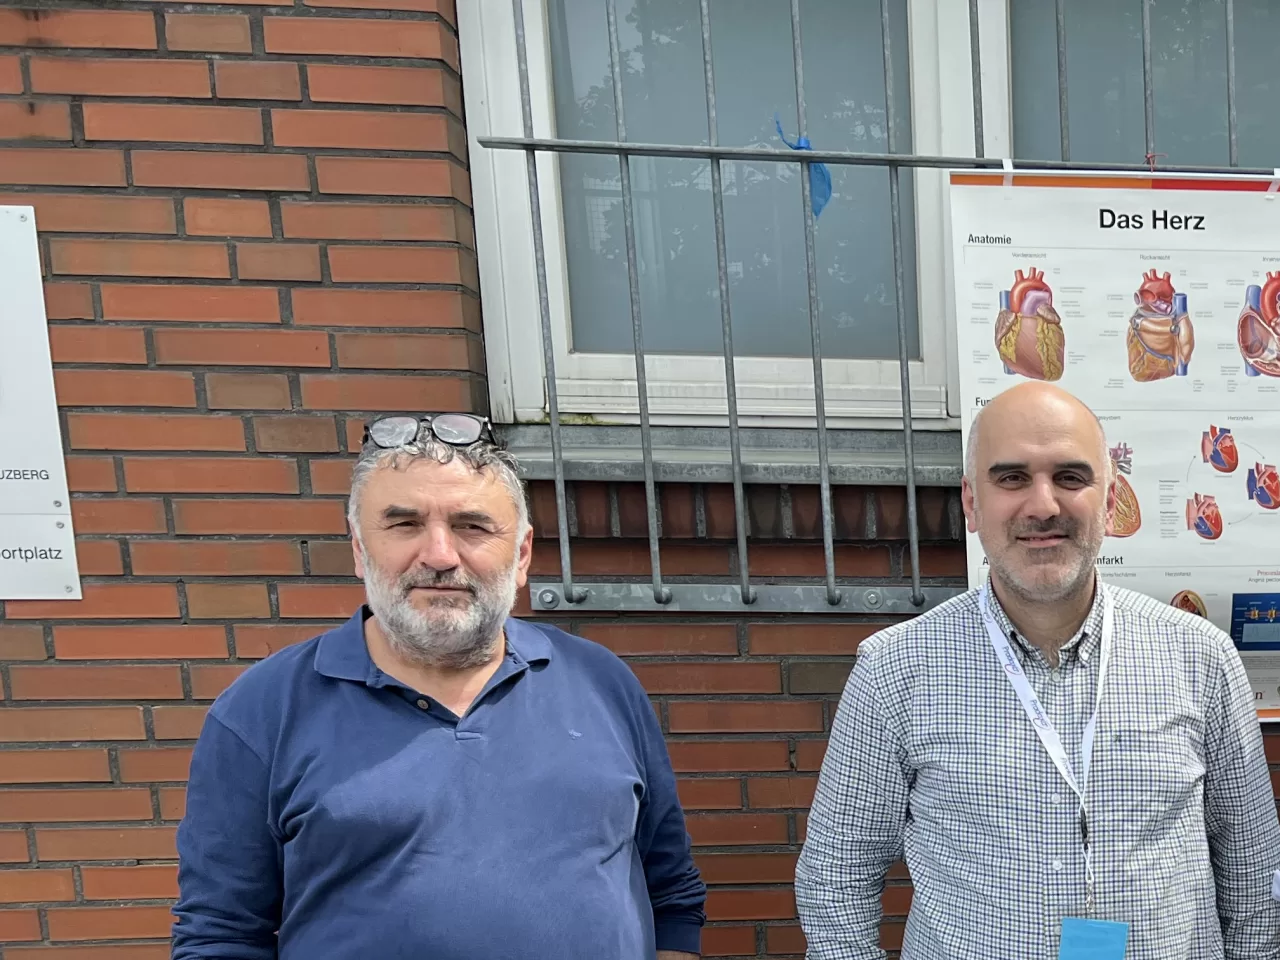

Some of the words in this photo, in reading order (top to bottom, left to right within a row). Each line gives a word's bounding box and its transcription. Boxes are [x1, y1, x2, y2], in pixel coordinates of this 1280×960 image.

[1099, 208, 1144, 229] Das
[1152, 209, 1206, 230] Herz
[967, 233, 1012, 245] Anatomie
[0, 546, 63, 563] ortplatz
[1096, 556, 1124, 565] nfarkt
